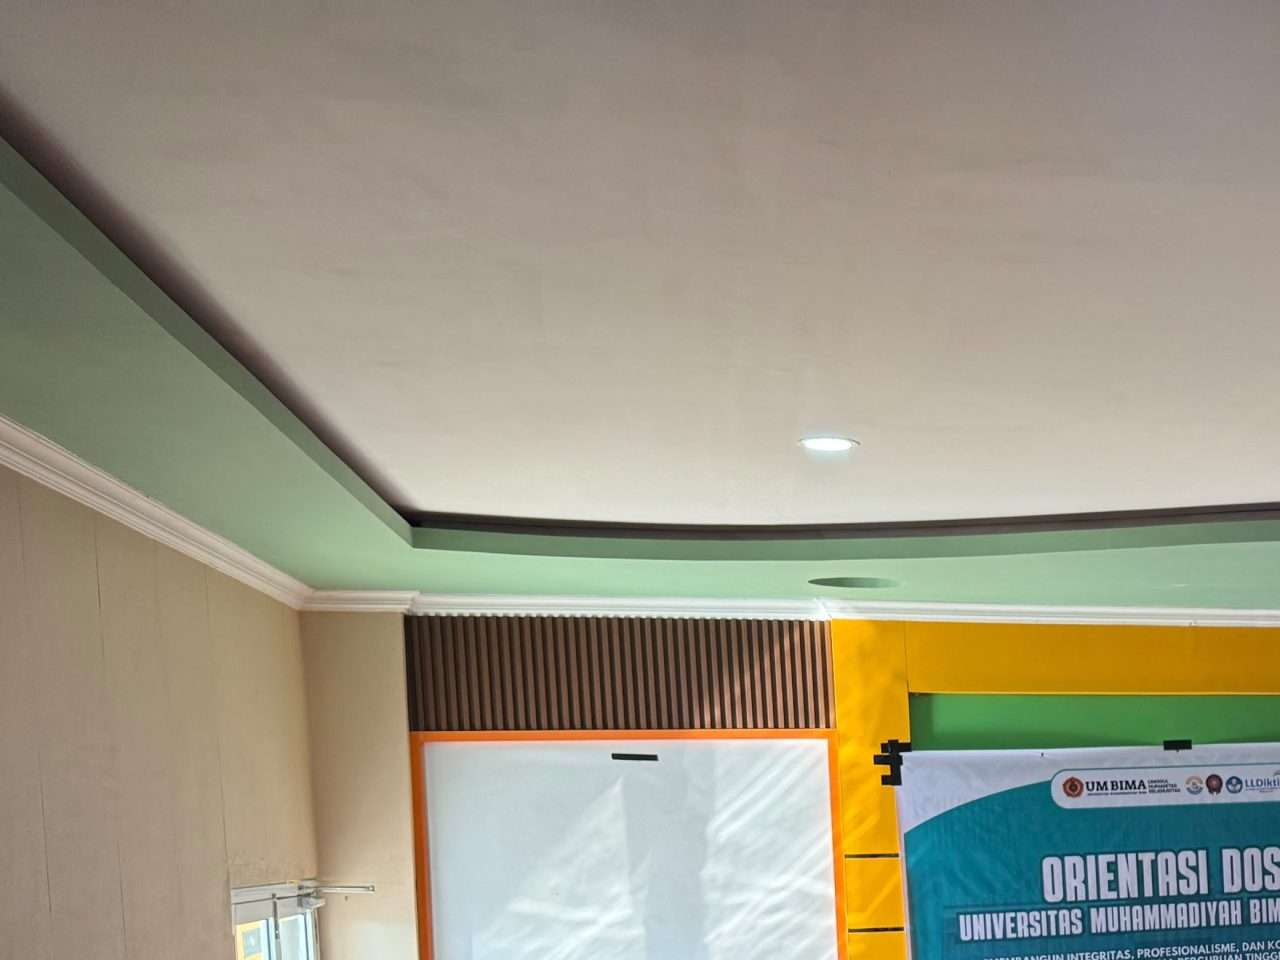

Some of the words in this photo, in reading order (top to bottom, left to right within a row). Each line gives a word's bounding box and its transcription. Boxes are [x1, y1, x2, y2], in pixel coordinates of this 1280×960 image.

[1086, 780, 1108, 791] UM
[1110, 779, 1147, 791] BIMA
[1042, 850, 1208, 903] ORIENTASI
[959, 909, 1083, 941] UNIVERSITAS
[1090, 900, 1242, 933] MUHAMMADIYAH
[1137, 943, 1240, 958] PROFESIONALISME,
[1243, 941, 1265, 952] DAN
